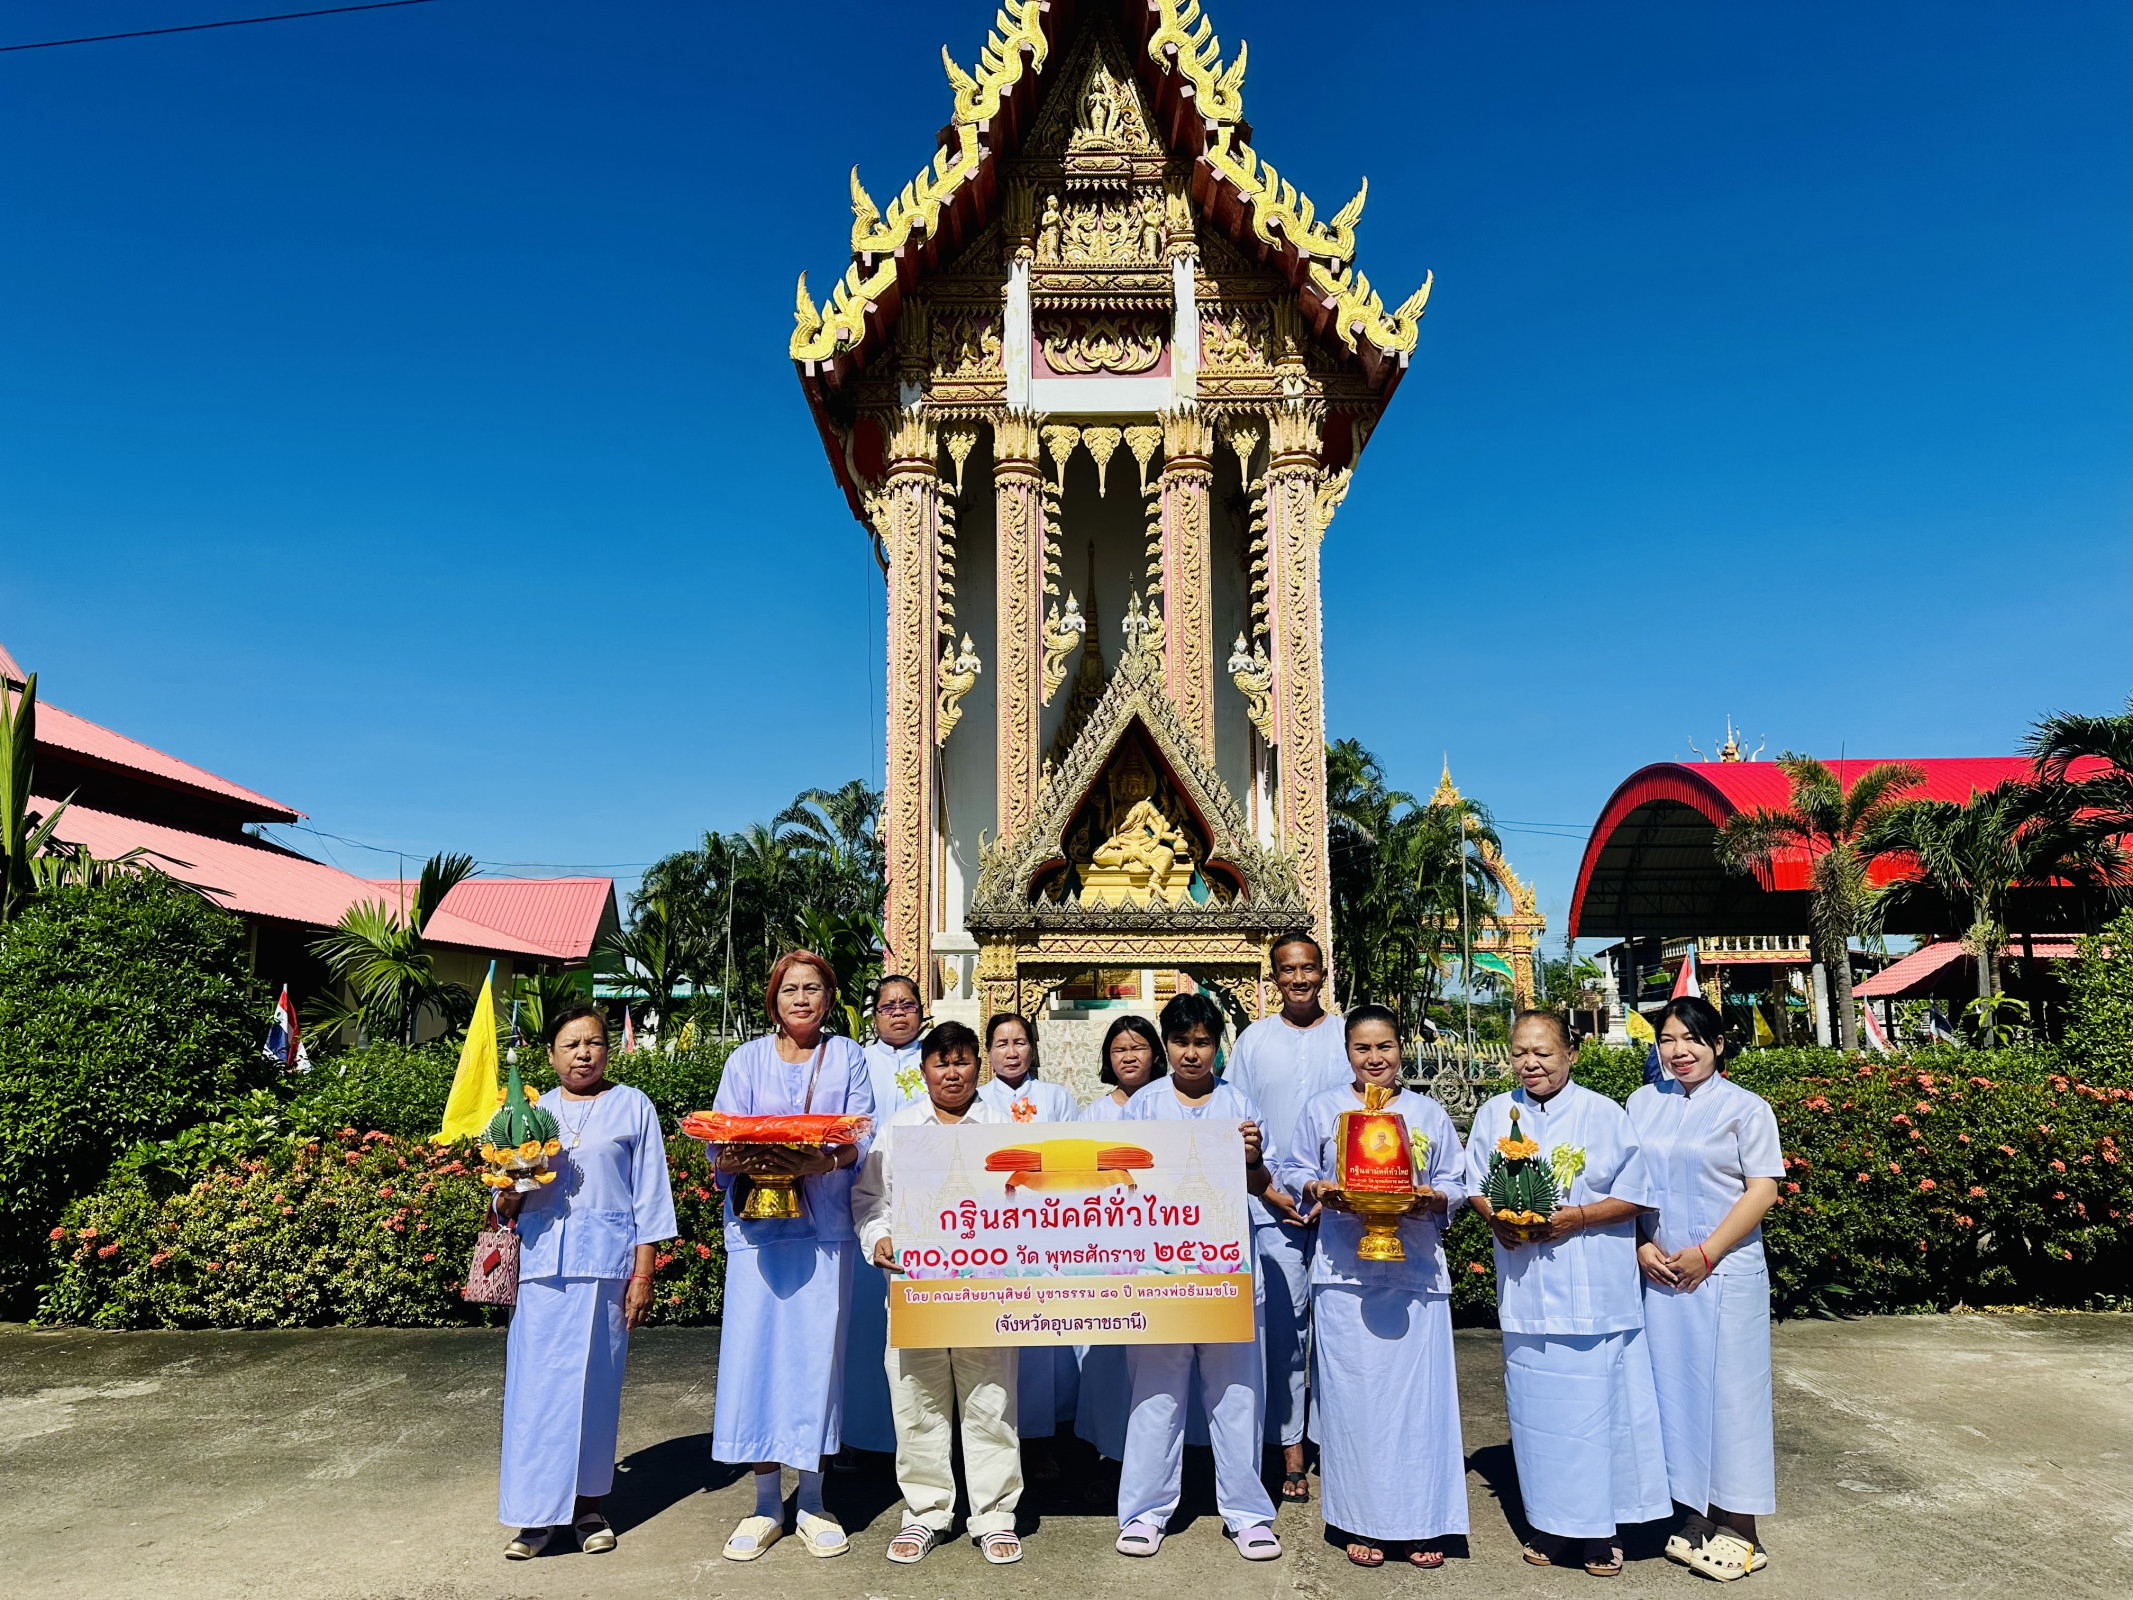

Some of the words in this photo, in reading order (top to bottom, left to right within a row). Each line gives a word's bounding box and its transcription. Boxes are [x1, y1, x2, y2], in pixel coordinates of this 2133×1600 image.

[940, 1188, 1200, 1239] กฐินสามัคคีทั่วไทย
[903, 1248, 1008, 1271] ๓๐,๐๐๐
[1016, 1245, 1039, 1265] วัด
[1045, 1243, 1145, 1272] พุทธศักราช
[1153, 1240, 1240, 1262] ๒๕๖๘
[905, 1288, 929, 1302] โดย
[933, 1286, 1031, 1304] คณะศิษยานุศิษย์
[1036, 1288, 1095, 1304] บูชาธรรม
[1100, 1289, 1119, 1299] ๘๑
[1123, 1284, 1133, 1298] ปี
[1136, 1283, 1237, 1298] หลวงพ่อธัมมชโย
[996, 1311, 1147, 1337] (จังหวัดอุบลราชธานี)
